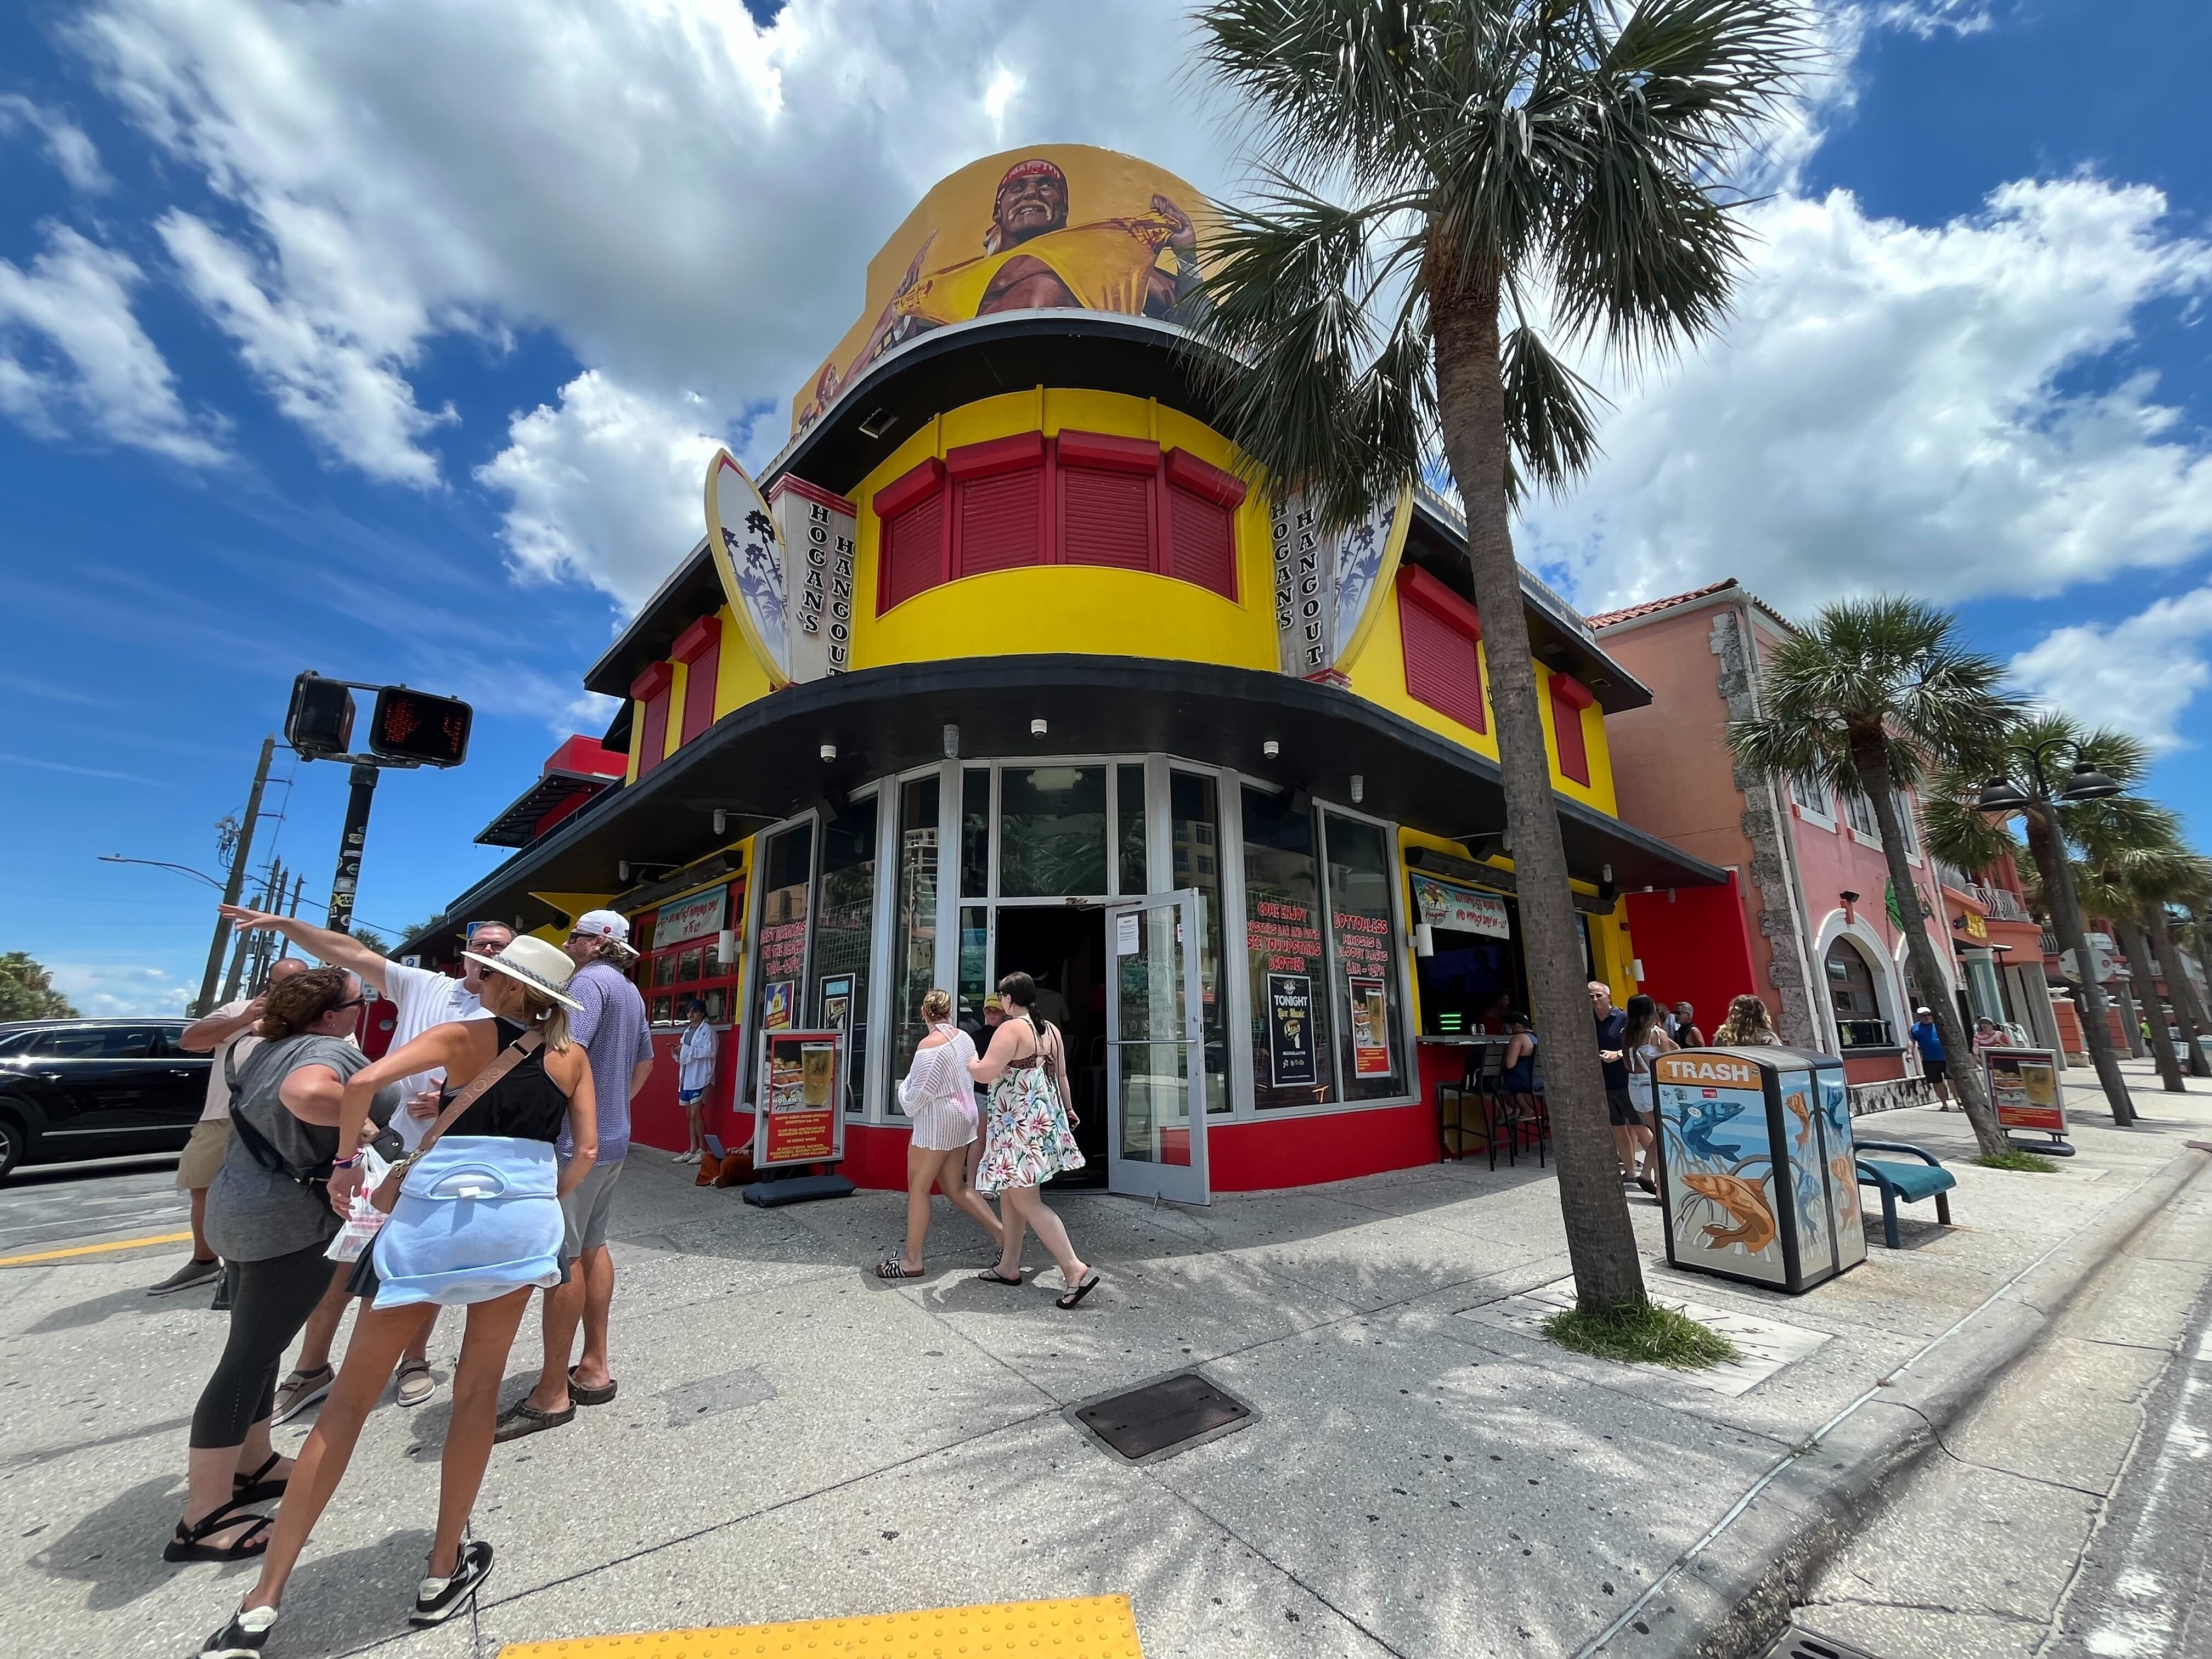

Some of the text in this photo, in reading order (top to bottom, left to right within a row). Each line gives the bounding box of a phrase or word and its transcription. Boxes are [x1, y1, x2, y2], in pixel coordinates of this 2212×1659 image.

[797, 502, 830, 634] HOGAN'S
[1296, 507, 1324, 666] HANGOUT
[1257, 901, 1307, 922] COME ENJOY
[1334, 911, 1388, 934] BOTTOMLESS
[1248, 934, 1262, 950] SEE
[1263, 936, 1282, 952] YOU
[1337, 945, 1364, 960] BLOODY
[1268, 954, 1305, 973] BROTHER
[1274, 995, 1308, 1007] TONIGHT
[1666, 1060, 1750, 1082] TRASH
